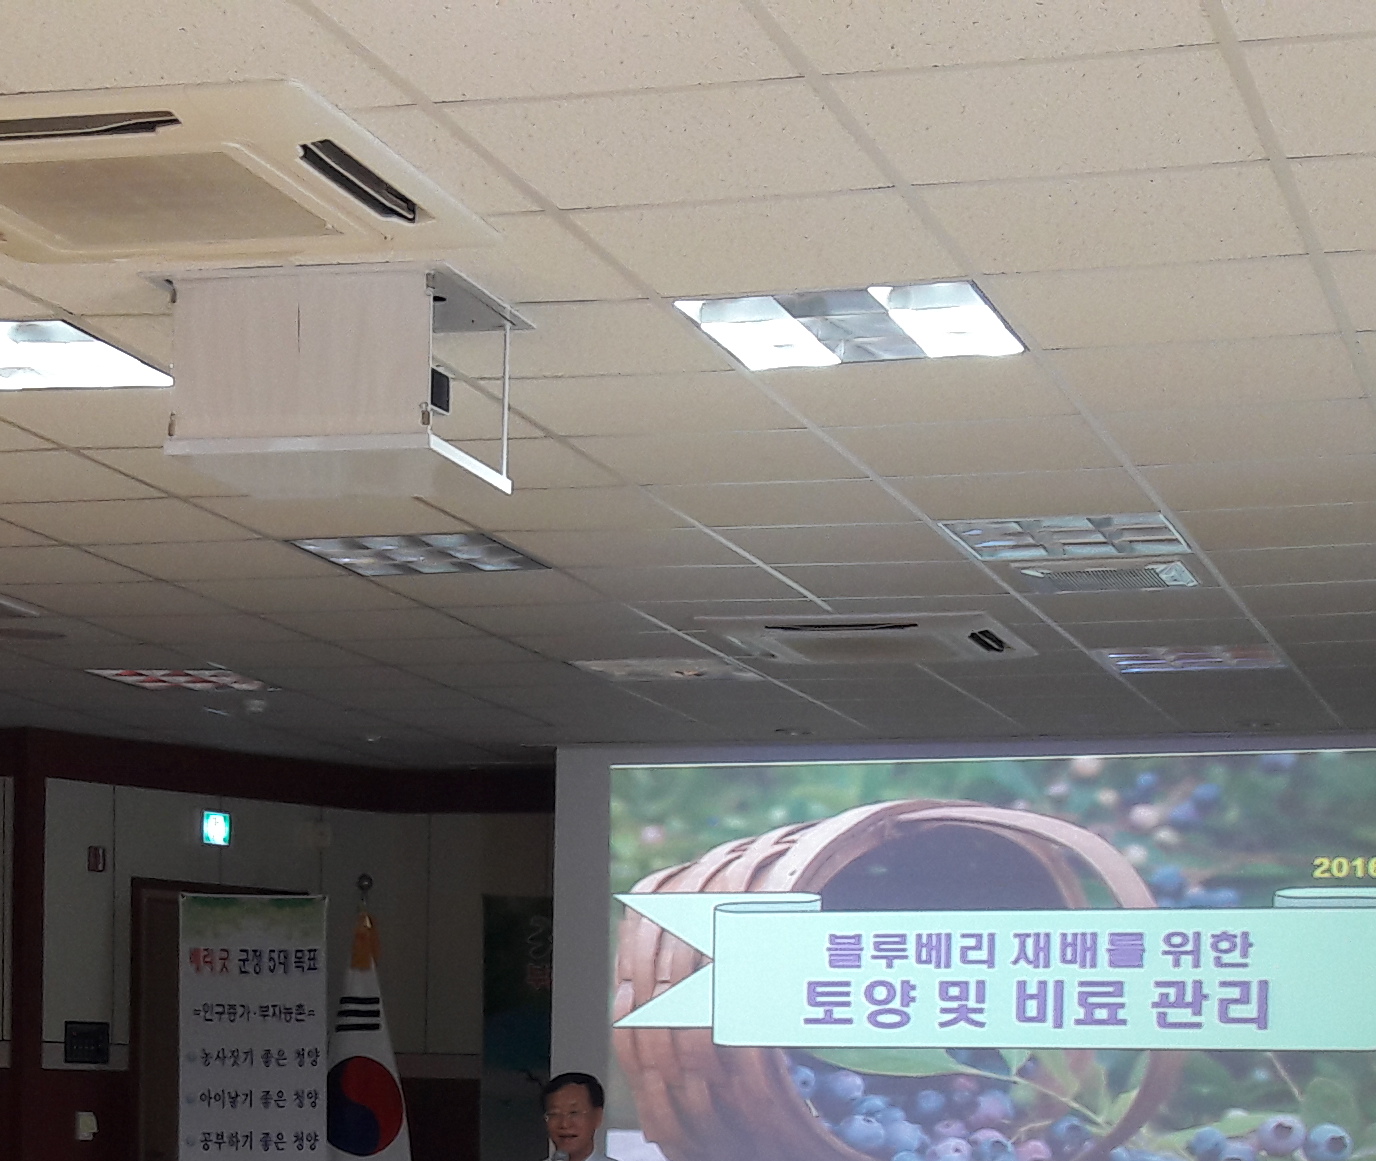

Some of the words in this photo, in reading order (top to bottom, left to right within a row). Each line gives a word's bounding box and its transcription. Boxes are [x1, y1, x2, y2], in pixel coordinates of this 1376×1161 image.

[826, 931, 996, 969] 블루베리
[1011, 931, 1146, 969] 재배를
[1161, 930, 1253, 969] 위한
[238, 949, 262, 975] 군정
[268, 949, 288, 974] 5대
[294, 949, 317, 972] 목표
[803, 979, 916, 1030] 토양
[938, 979, 987, 1028] 및
[1016, 979, 1128, 1028] 비료
[1151, 979, 1269, 1030] 관리
[201, 1047, 254, 1067] 농사짓기
[261, 1047, 287, 1067] 좋은
[296, 1047, 321, 1067] 청양
[260, 1089, 287, 1109] 좋은
[293, 1089, 319, 1109] 청양
[200, 1131, 253, 1151] 공부하기
[260, 1131, 287, 1151] 좋은
[293, 1131, 319, 1151] 청양
